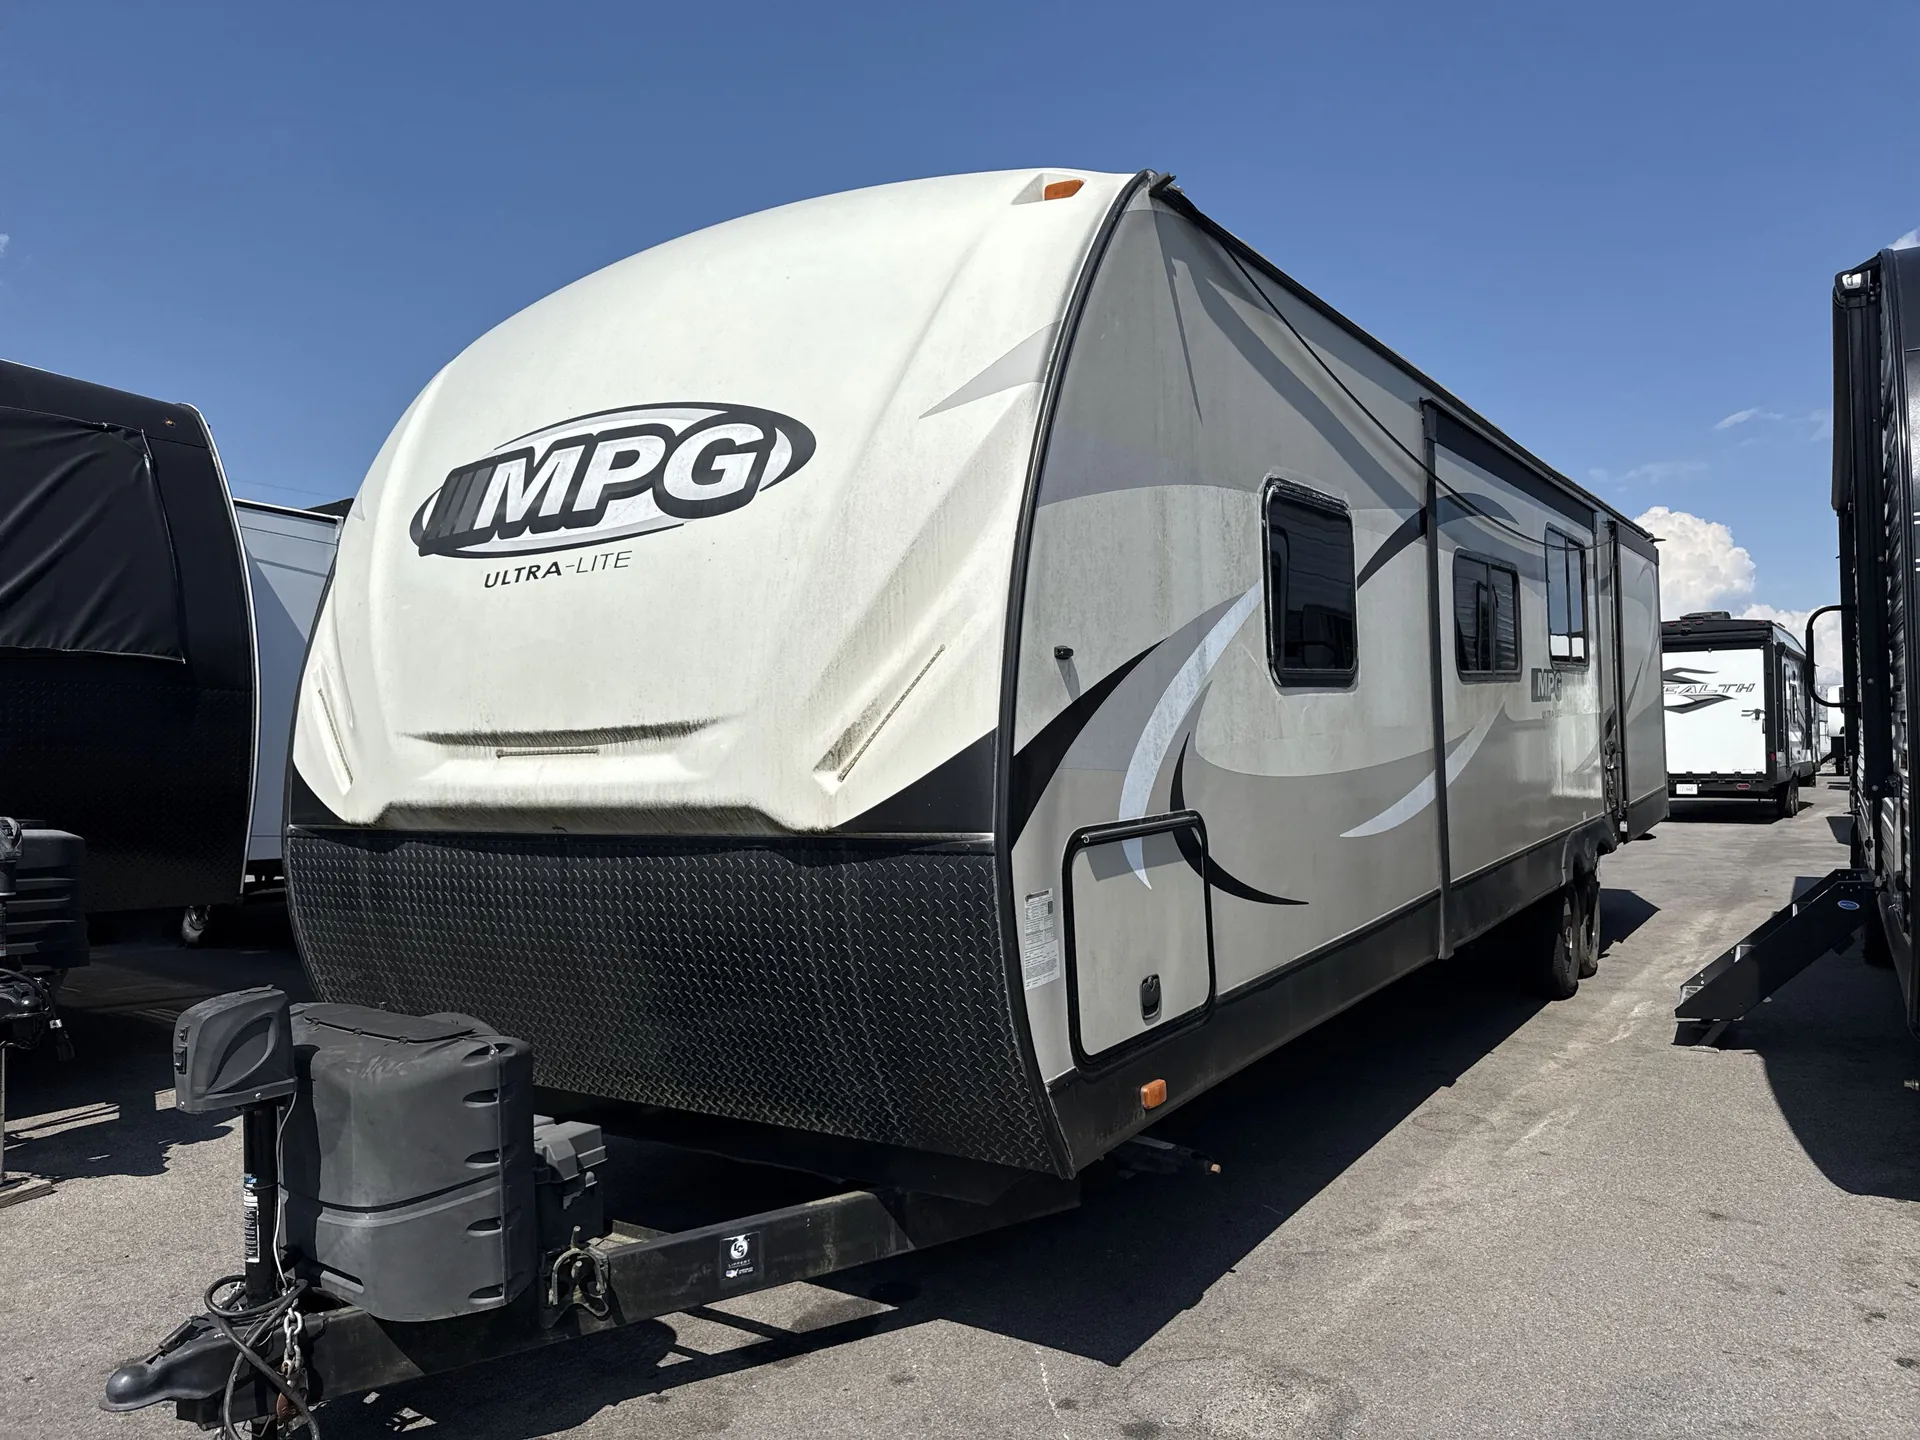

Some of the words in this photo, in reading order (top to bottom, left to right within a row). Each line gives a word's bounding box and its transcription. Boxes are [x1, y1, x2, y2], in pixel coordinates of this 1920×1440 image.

[471, 421, 767, 532] MPG
[484, 550, 633, 589] ULTRA-LITE
[1536, 670, 1562, 697] MPG
[1663, 682, 1756, 695] EALTH
